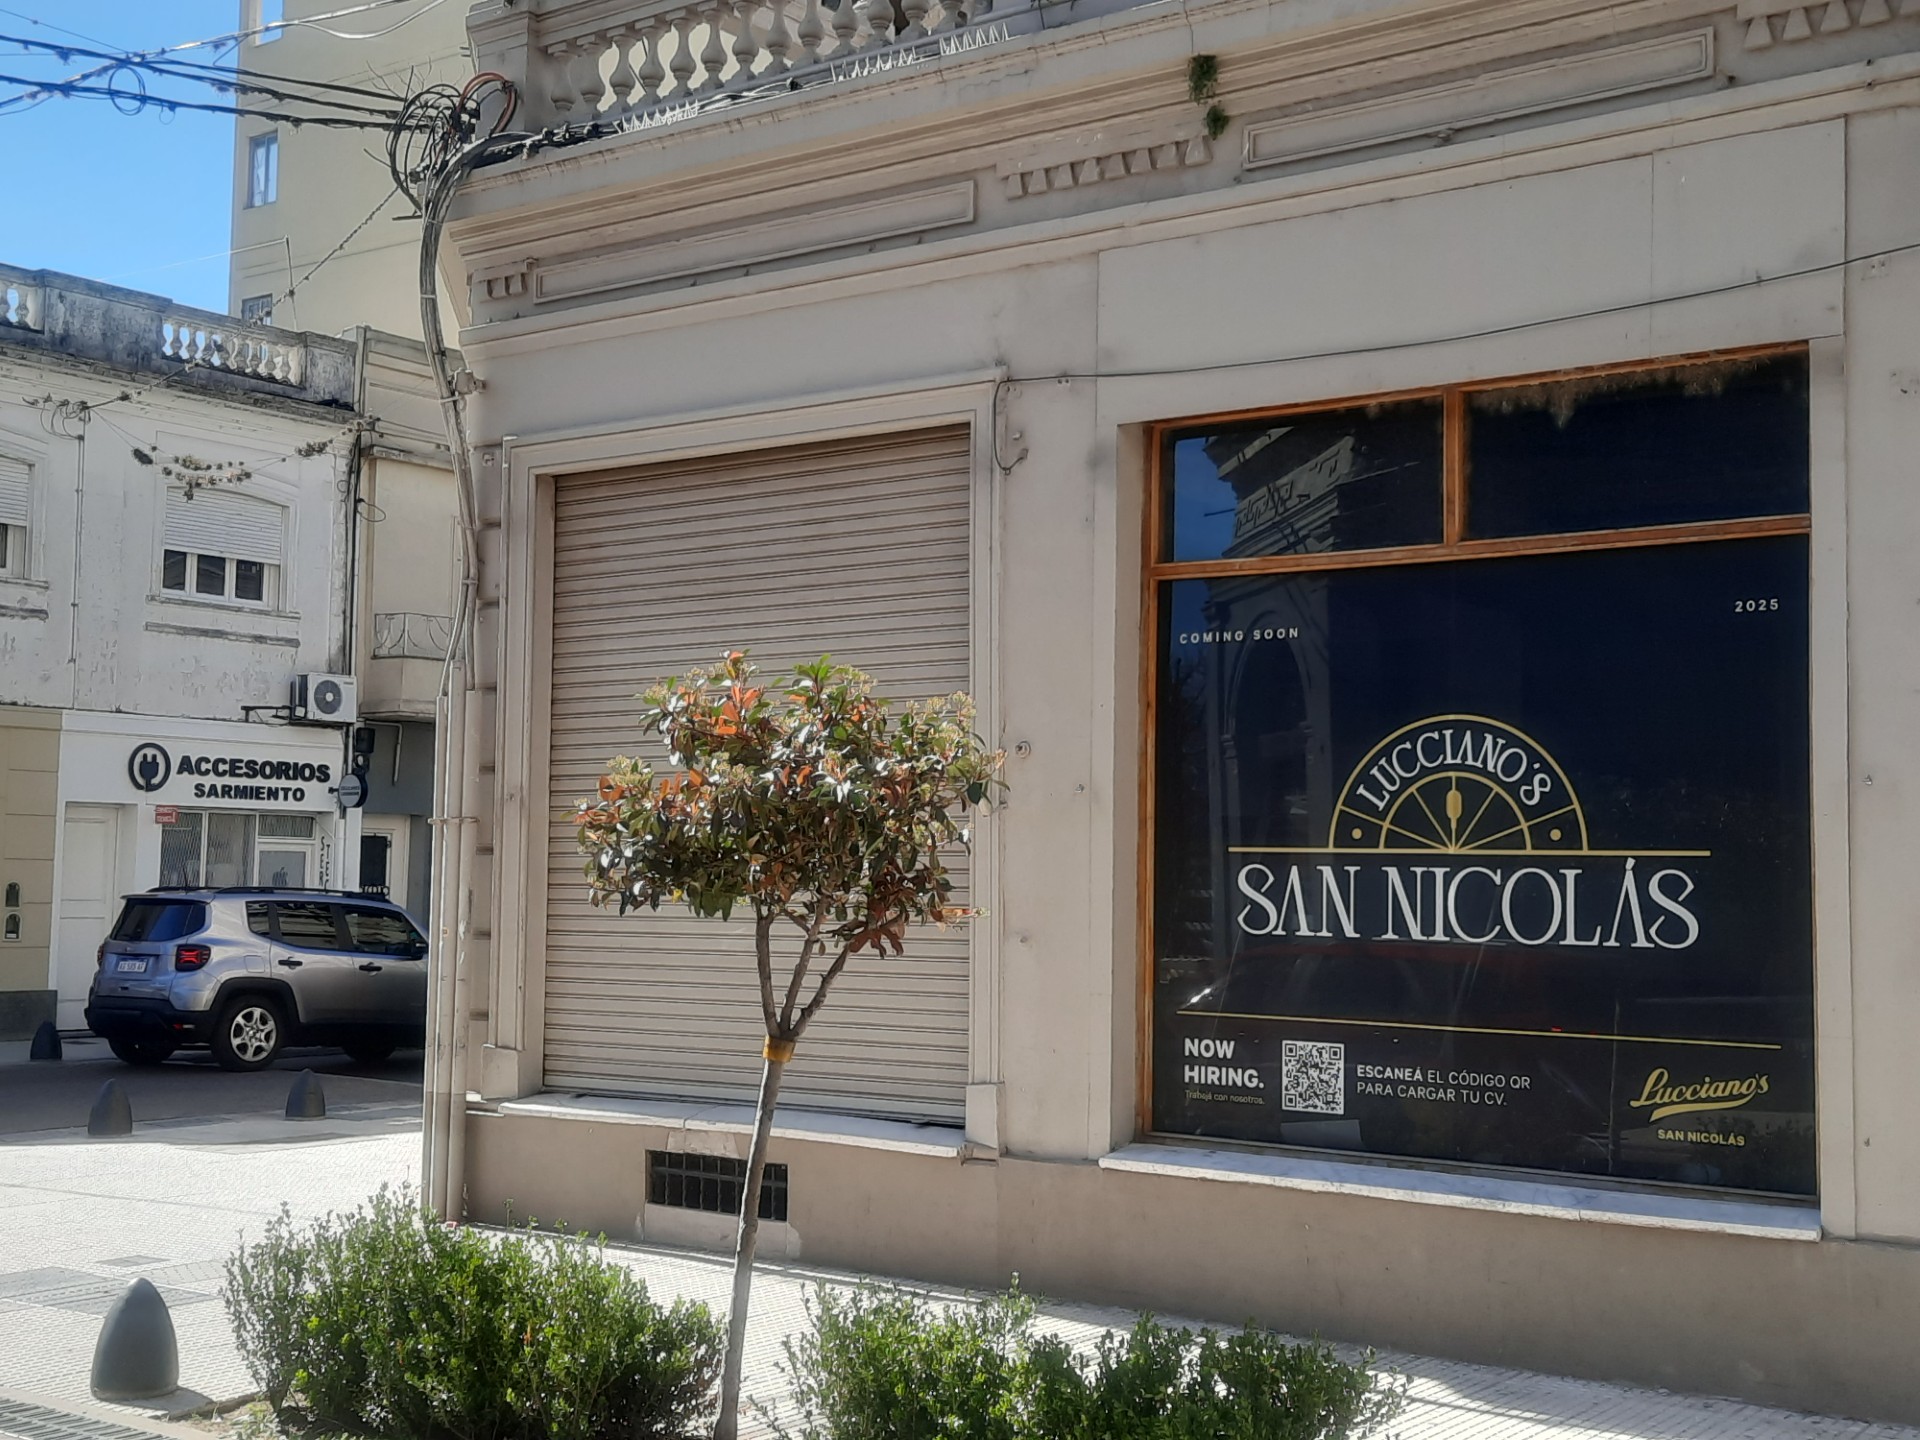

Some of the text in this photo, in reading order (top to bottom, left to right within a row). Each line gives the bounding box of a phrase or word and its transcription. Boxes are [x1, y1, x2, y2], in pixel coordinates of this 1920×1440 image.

[1734, 598, 1779, 613] 2025
[1179, 627, 1298, 644] COMING SOON
[176, 755, 331, 783] ACCESORIOS
[1356, 729, 1552, 811] LUCCIANO'S
[194, 783, 306, 802] SARMIENTO
[1237, 857, 1699, 949] SAN NICOLÁS
[1184, 1038, 1235, 1059] NOW
[1184, 1064, 1265, 1089] HIRING.
[1356, 1064, 1531, 1090] ESCANEÁ EL CÓDIGO QR
[1629, 1068, 1769, 1108] Lucciano's
[1357, 1081, 1508, 1106] PARA CARGAR TU CV.
[1657, 1129, 1746, 1146] SAN NICOLÁS
